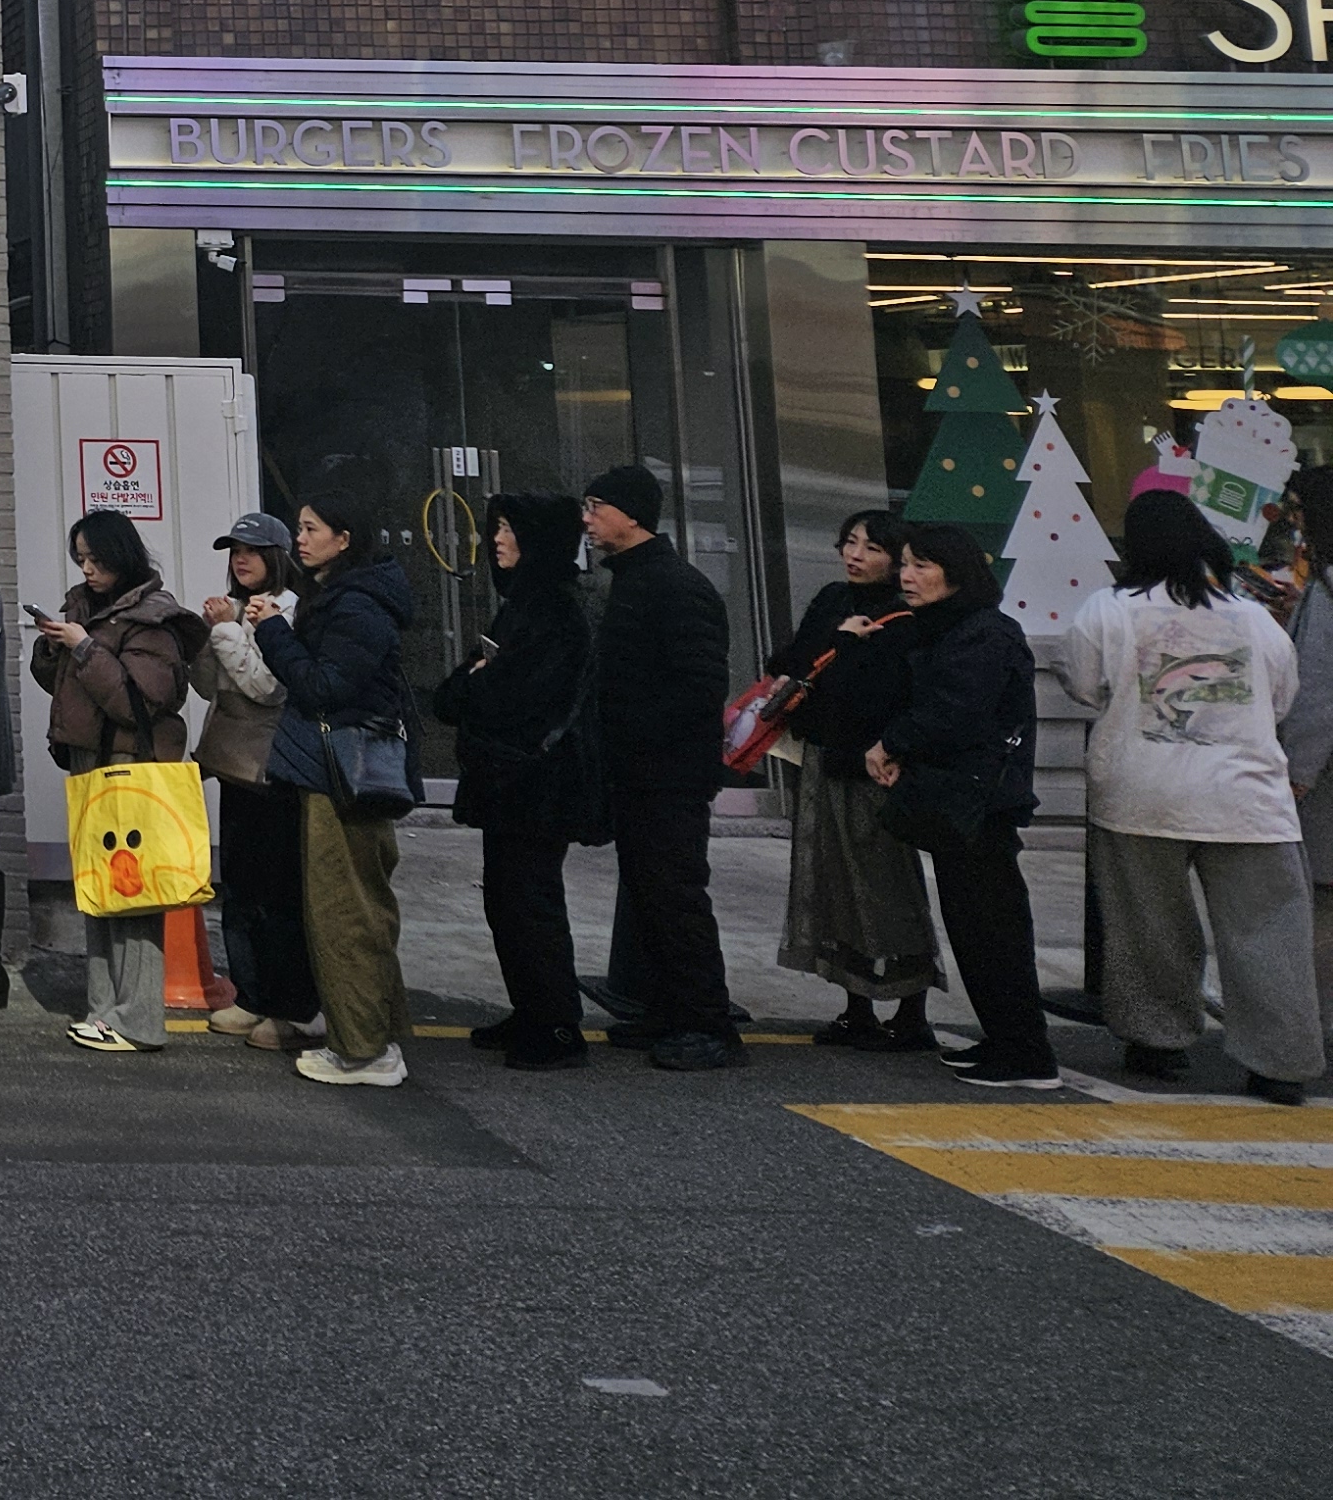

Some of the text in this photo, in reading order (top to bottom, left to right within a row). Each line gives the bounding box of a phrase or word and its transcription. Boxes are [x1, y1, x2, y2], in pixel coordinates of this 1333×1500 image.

[168, 117, 1311, 183] BURGERS FROZEN CUSTARD FRIES
